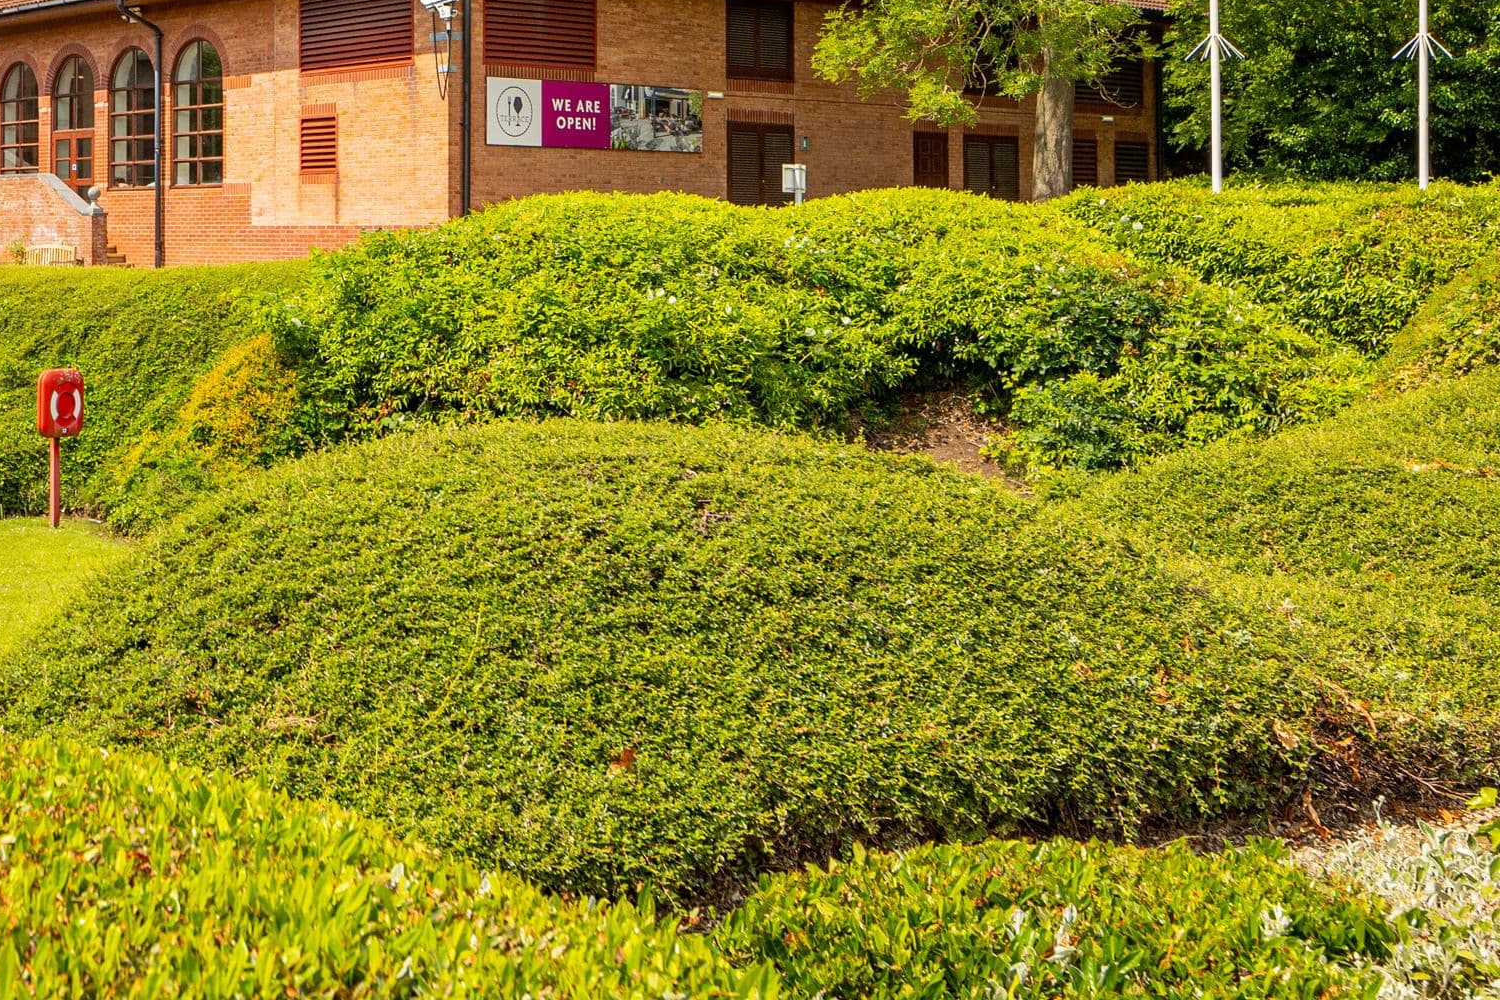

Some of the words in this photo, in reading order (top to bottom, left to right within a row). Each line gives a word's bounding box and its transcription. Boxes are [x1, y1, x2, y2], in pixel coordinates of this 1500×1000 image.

[551, 98, 572, 112] WE
[576, 99, 601, 114] ARE
[556, 115, 597, 130] OPEN!
